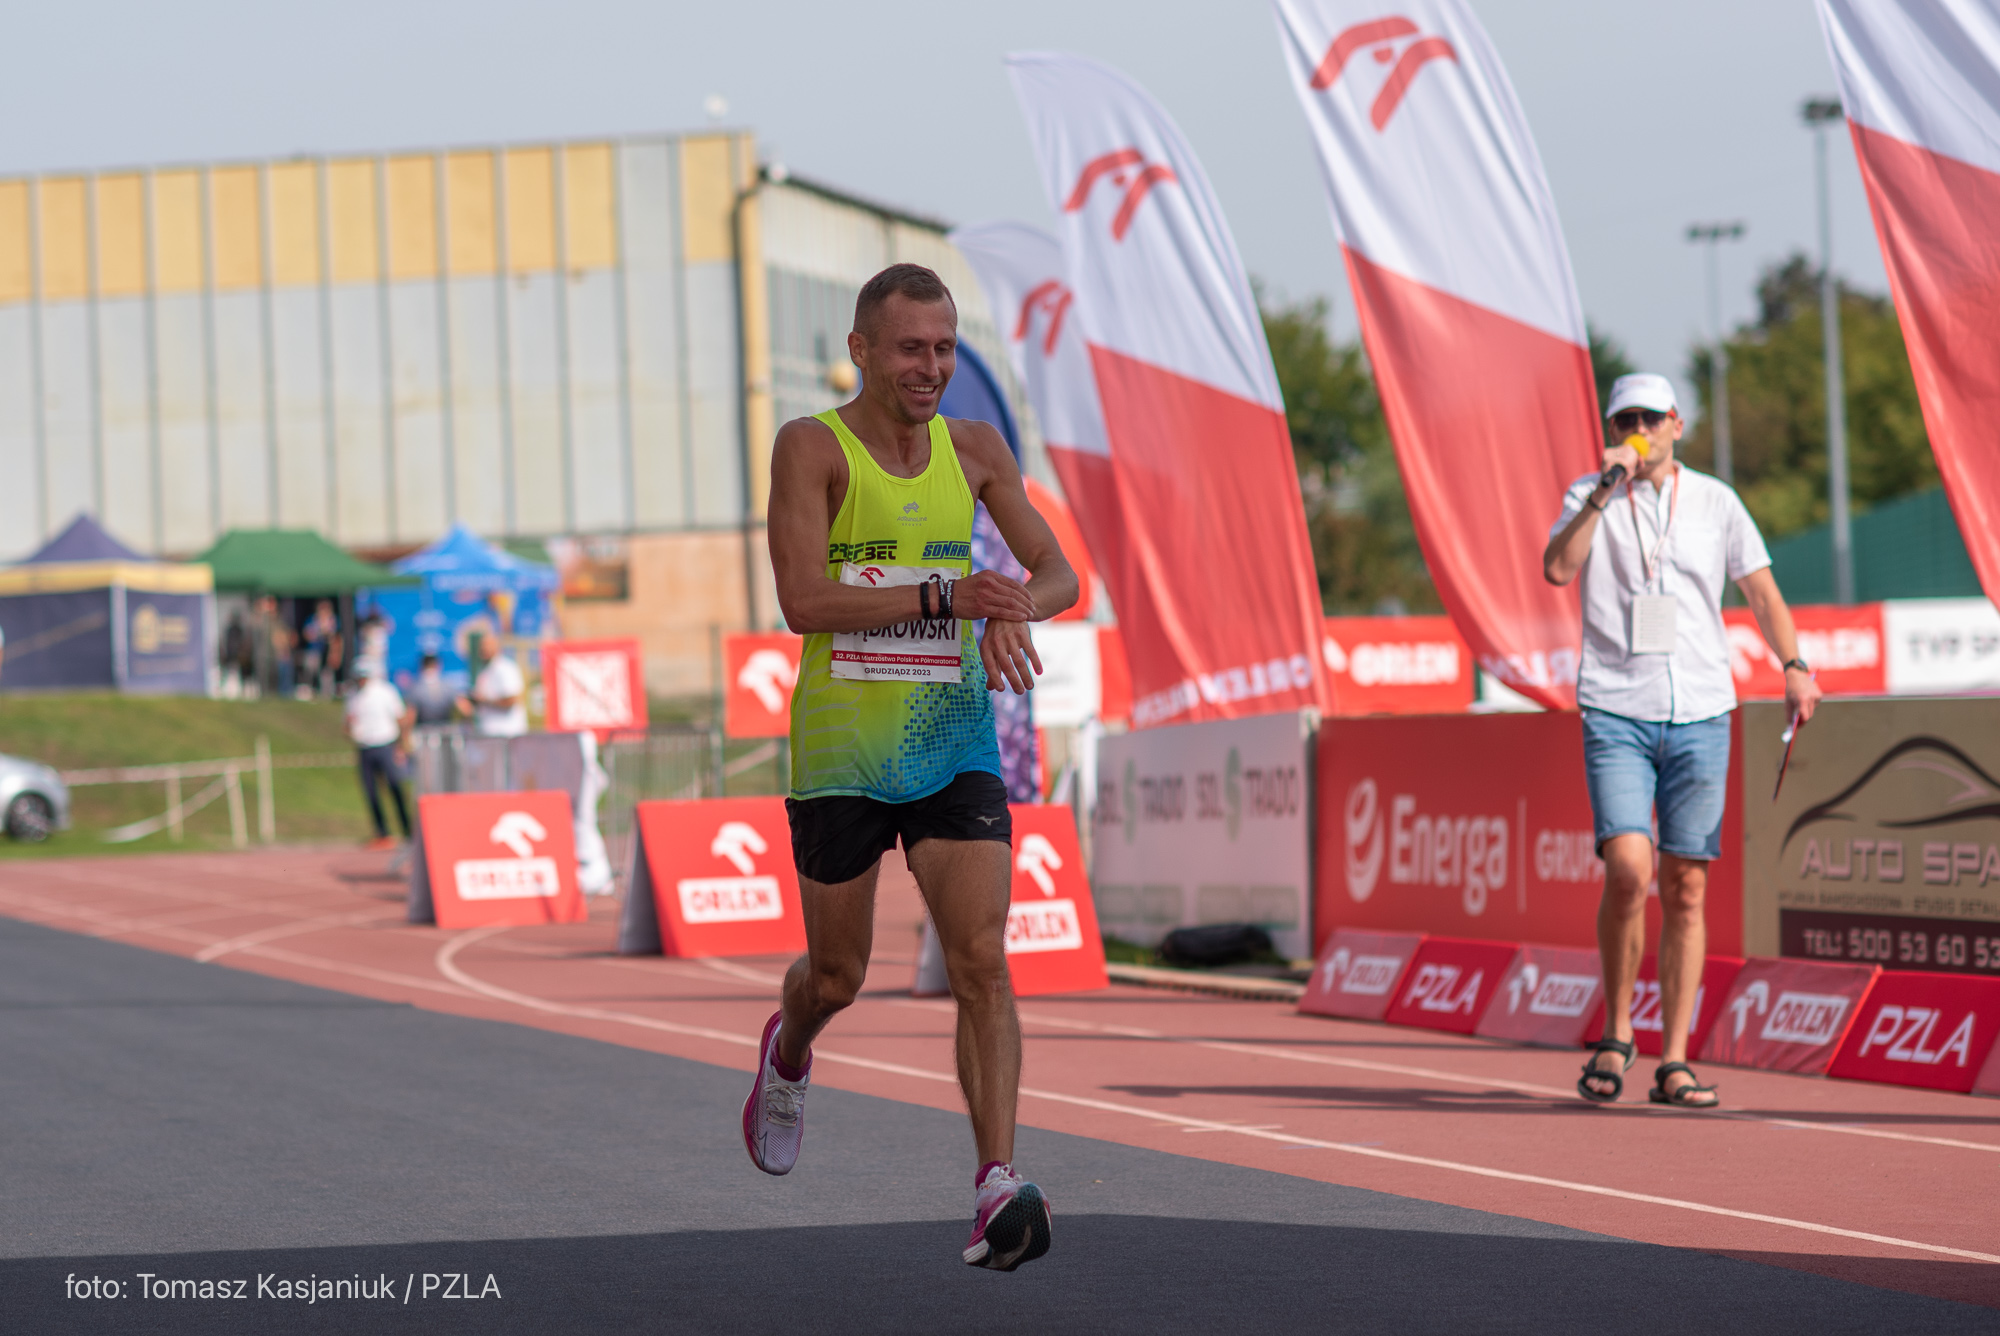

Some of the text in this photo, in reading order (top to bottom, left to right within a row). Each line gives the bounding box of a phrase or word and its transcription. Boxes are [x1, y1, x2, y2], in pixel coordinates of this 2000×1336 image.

[921, 541, 970, 560] SONARO
[840, 619, 956, 642] BROWSKI
[846, 653, 860, 661] PZLA
[861, 654, 896, 663] Mistrzostwa
[896, 655, 914, 664] Polski
[920, 656, 958, 665] Półmaratonie
[864, 667, 931, 677] GRUDZIĄDZ 2023
[1389, 793, 1509, 917] Energa
[1534, 828, 1606, 883] GRUP
[1800, 838, 1905, 882] AUTO
[1803, 928, 1842, 956] TEL:
[1848, 928, 1891, 960] 500
[1899, 931, 1927, 963] 53
[1935, 934, 1966, 966] 60
[1402, 964, 1485, 1016] PZLA
[1857, 1004, 1977, 1068] PZLA
